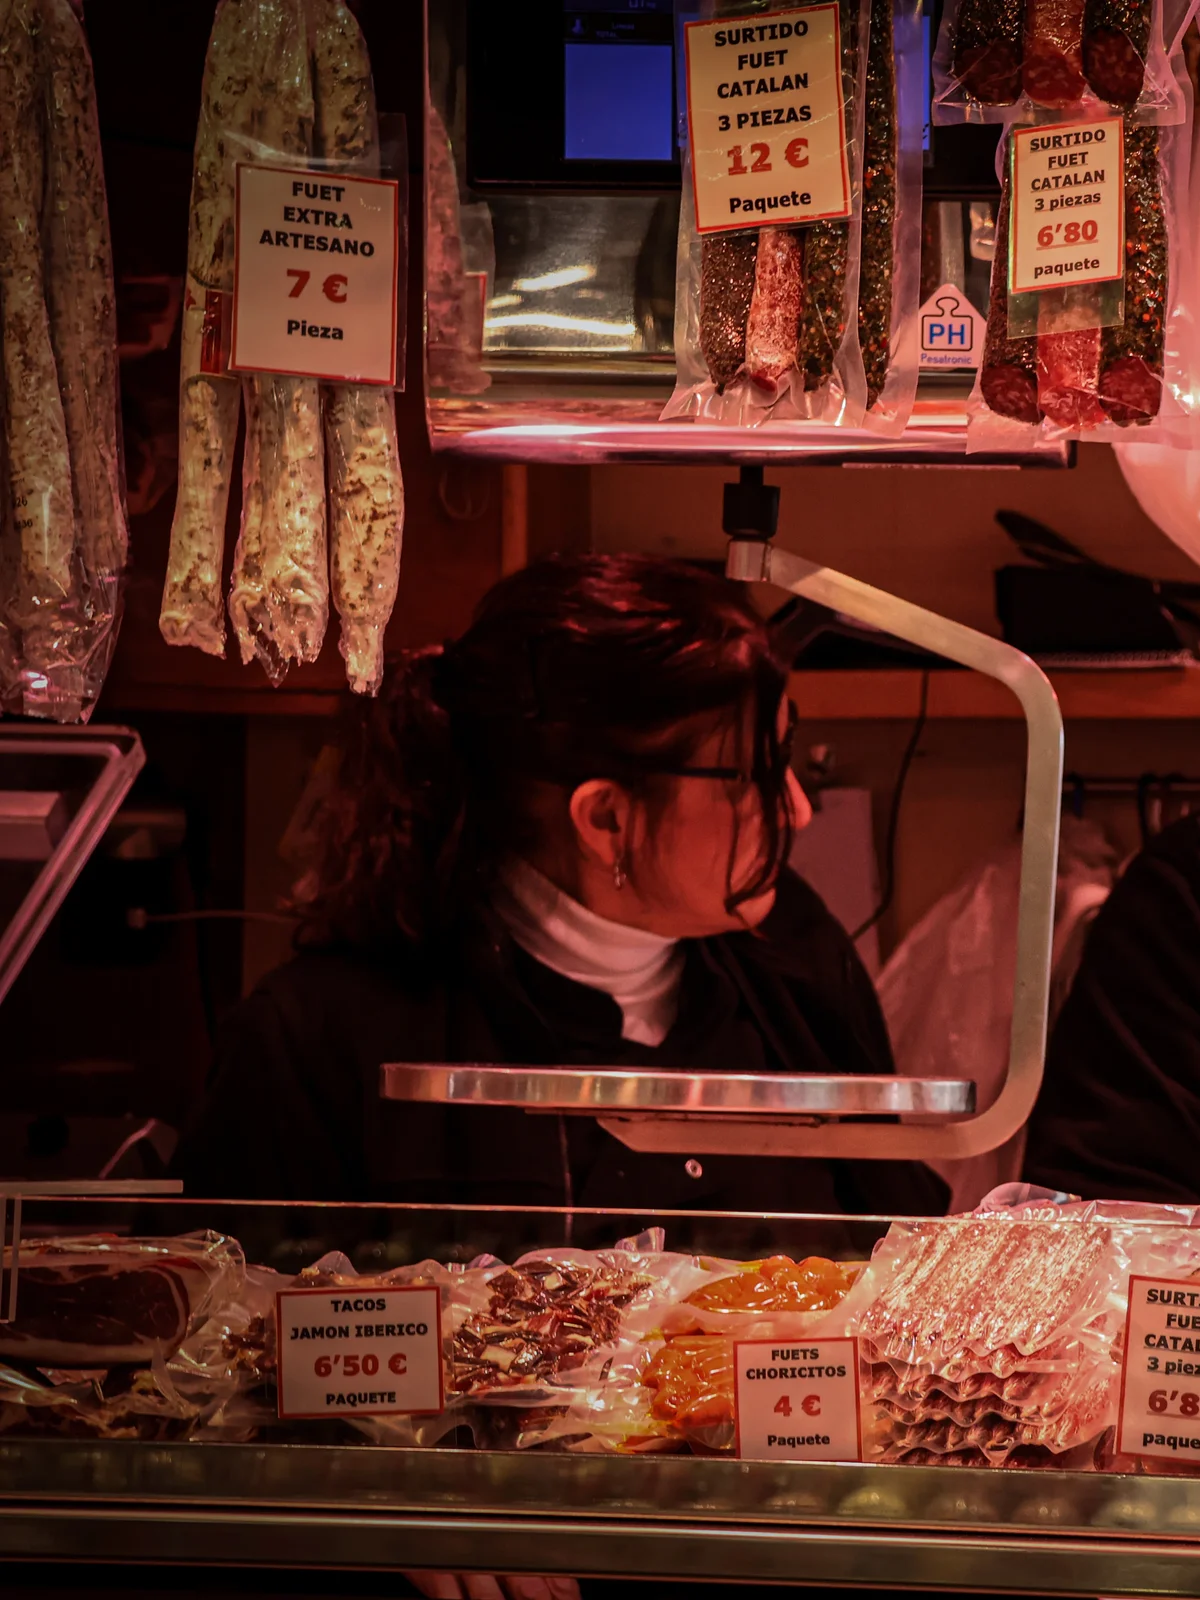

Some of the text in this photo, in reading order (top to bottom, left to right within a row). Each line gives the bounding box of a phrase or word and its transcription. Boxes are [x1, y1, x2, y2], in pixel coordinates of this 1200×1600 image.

[714, 20, 810, 46] SURTIDO
[737, 50, 788, 70] FUET
[717, 72, 809, 99] CATALAN
[718, 104, 812, 131] 3 PIEZAS
[1030, 129, 1107, 151] SURTIDO
[727, 138, 810, 175] 12 €
[1048, 150, 1088, 167] FUET
[1031, 169, 1105, 190] CATALAN
[292, 181, 345, 203] FUET
[729, 190, 811, 215] Paquete
[1035, 191, 1101, 211] 3 piezas
[283, 207, 353, 230] EXTRA
[259, 229, 375, 257] ARTESANO
[1037, 220, 1098, 245] 6'80
[1033, 257, 1100, 278] paquete
[287, 268, 348, 303] 7 €
[287, 318, 344, 342] Pieza
[929, 323, 965, 345] PH
[331, 1297, 386, 1313] TACOS
[290, 1322, 428, 1340] JAMON IBERICO
[314, 1353, 407, 1377] 6'50 €
[771, 1348, 819, 1361] FUETS
[1147, 1357, 1159, 1374] 3
[745, 1366, 847, 1380] CHORICITOS
[325, 1391, 396, 1406] PAQUETE
[773, 1394, 822, 1417] 4 €
[767, 1433, 831, 1447] Paquete
